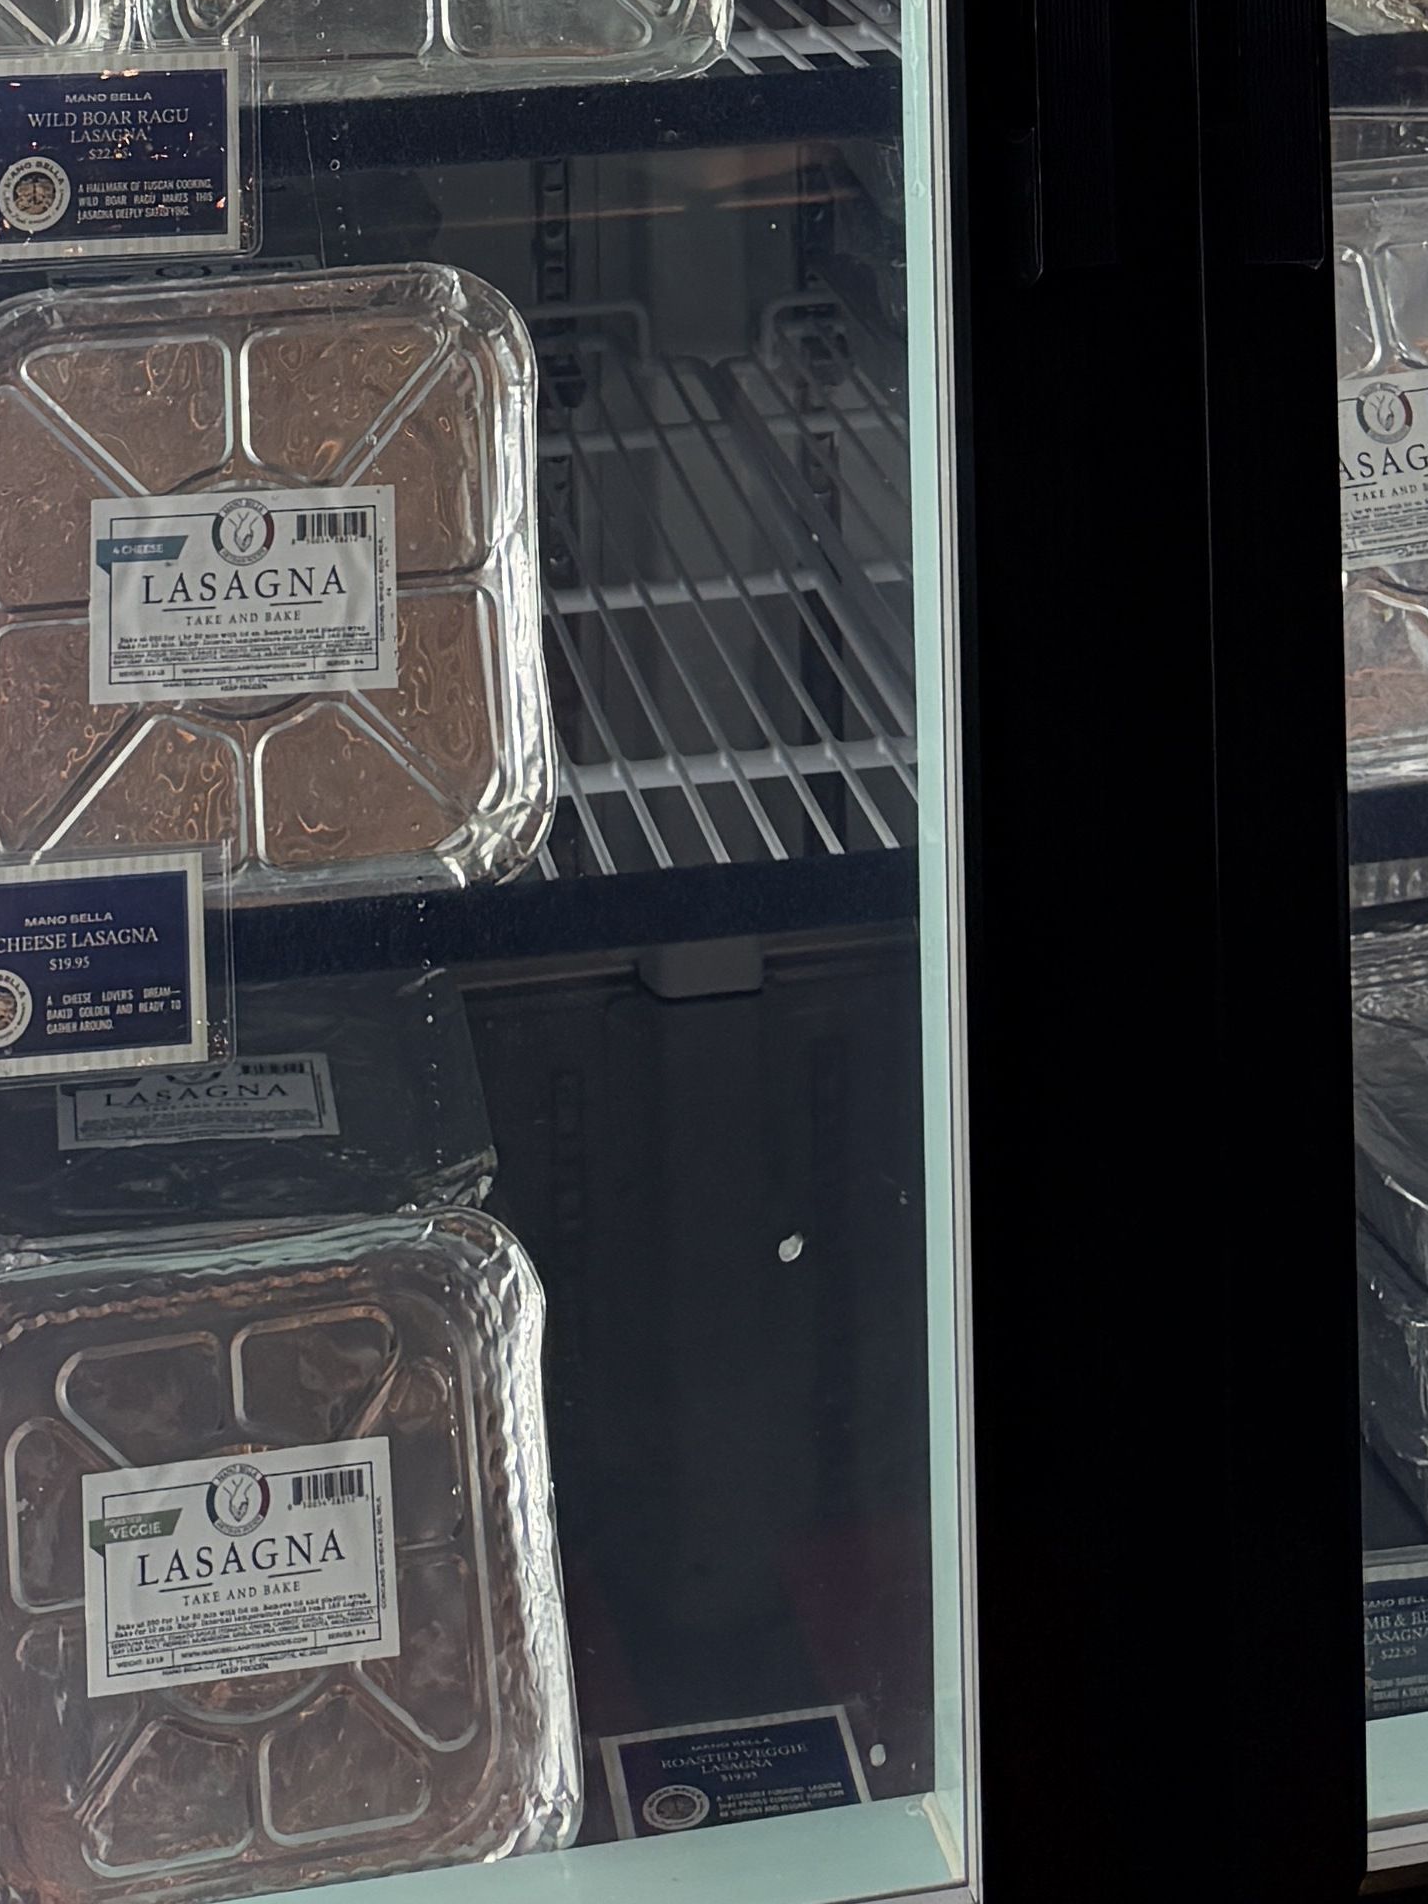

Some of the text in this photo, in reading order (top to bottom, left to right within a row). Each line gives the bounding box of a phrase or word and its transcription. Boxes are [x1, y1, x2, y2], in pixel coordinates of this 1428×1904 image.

[65, 92, 152, 103] MANO BELLA
[28, 108, 189, 128] WILD BOAR RAGU
[71, 128, 148, 143] LASAGNA
[121, 543, 164, 554] CHEESE
[142, 564, 347, 605] LASAGNA
[24, 912, 113, 928] MANO BELLA
[71, 928, 159, 948] LASAGNA
[49, 956, 90, 972] $19.95
[104, 1082, 289, 1107] LASAGNA
[109, 1521, 162, 1540] VEGGIE
[136, 1529, 347, 1587] LASAGNA
[182, 1581, 302, 1607] TAKE AND BAKE
[661, 1745, 808, 1769] ROASTED VEGGIE
[701, 1759, 773, 1774] LASAGNA
